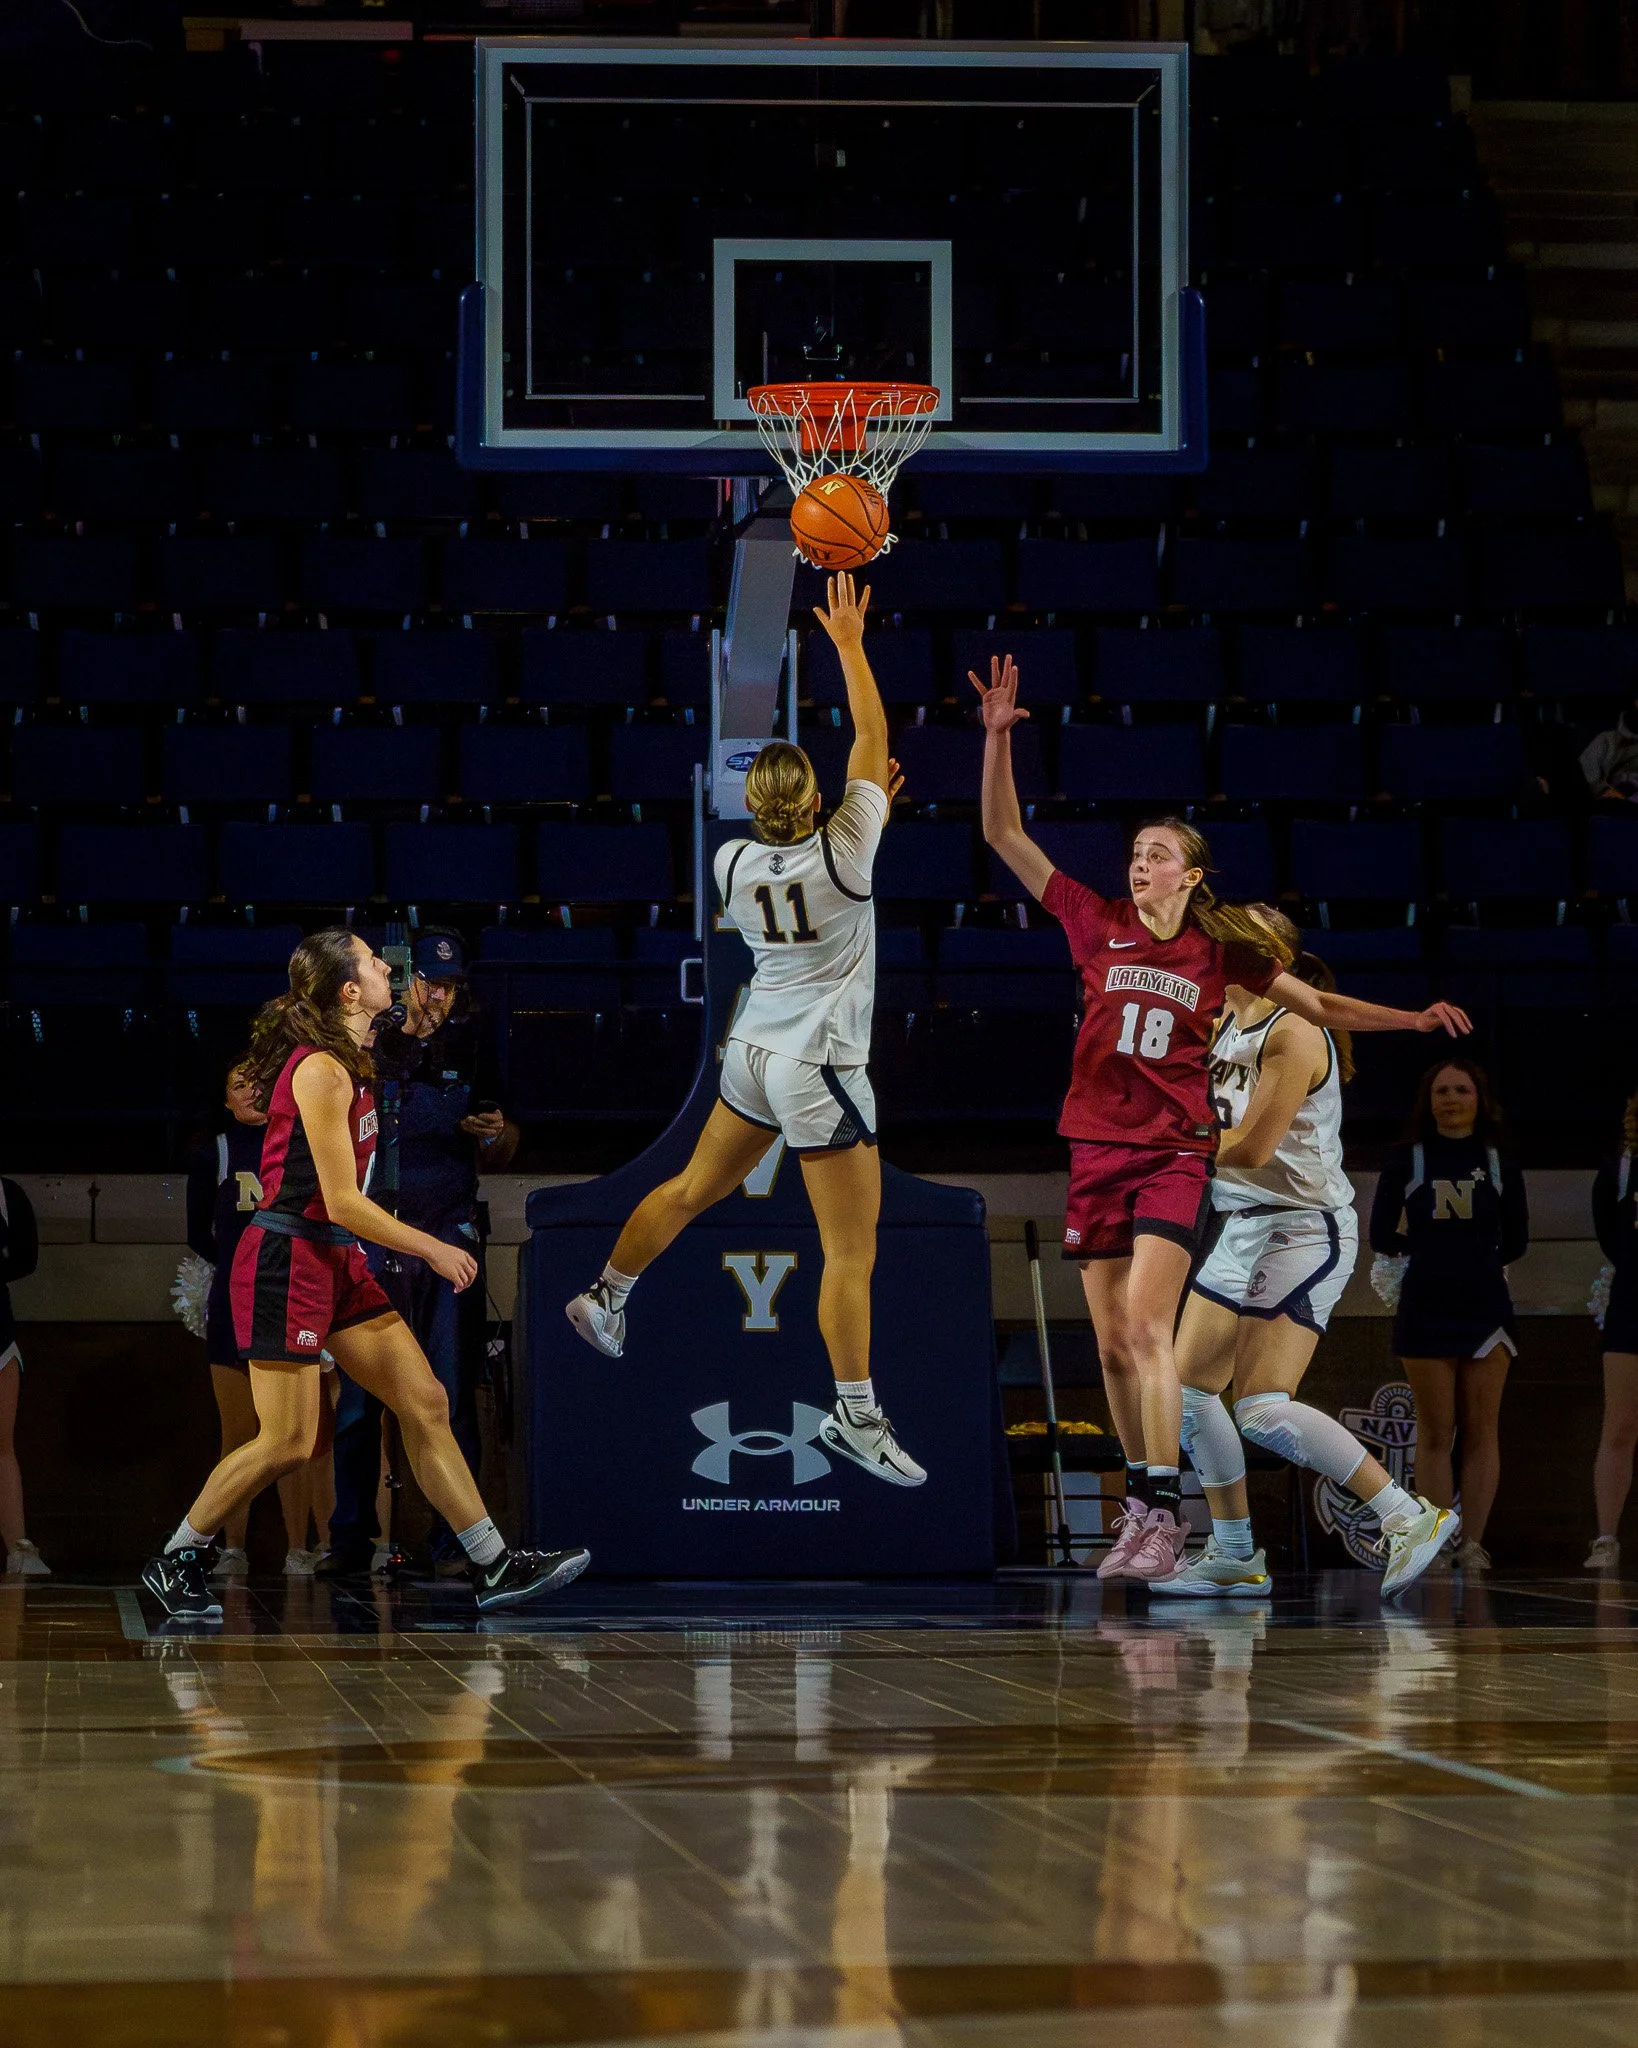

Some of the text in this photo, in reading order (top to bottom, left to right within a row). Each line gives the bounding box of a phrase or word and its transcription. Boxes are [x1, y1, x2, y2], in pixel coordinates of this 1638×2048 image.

[755, 884, 818, 942] 11
[1109, 967, 1197, 1007] LAFAYETTE
[1116, 1002, 1175, 1060] 18
[1432, 1179, 1475, 1219] N
[1361, 1418, 1415, 1443] NAV
[682, 1498, 841, 1512] UNDER ARMOUR
